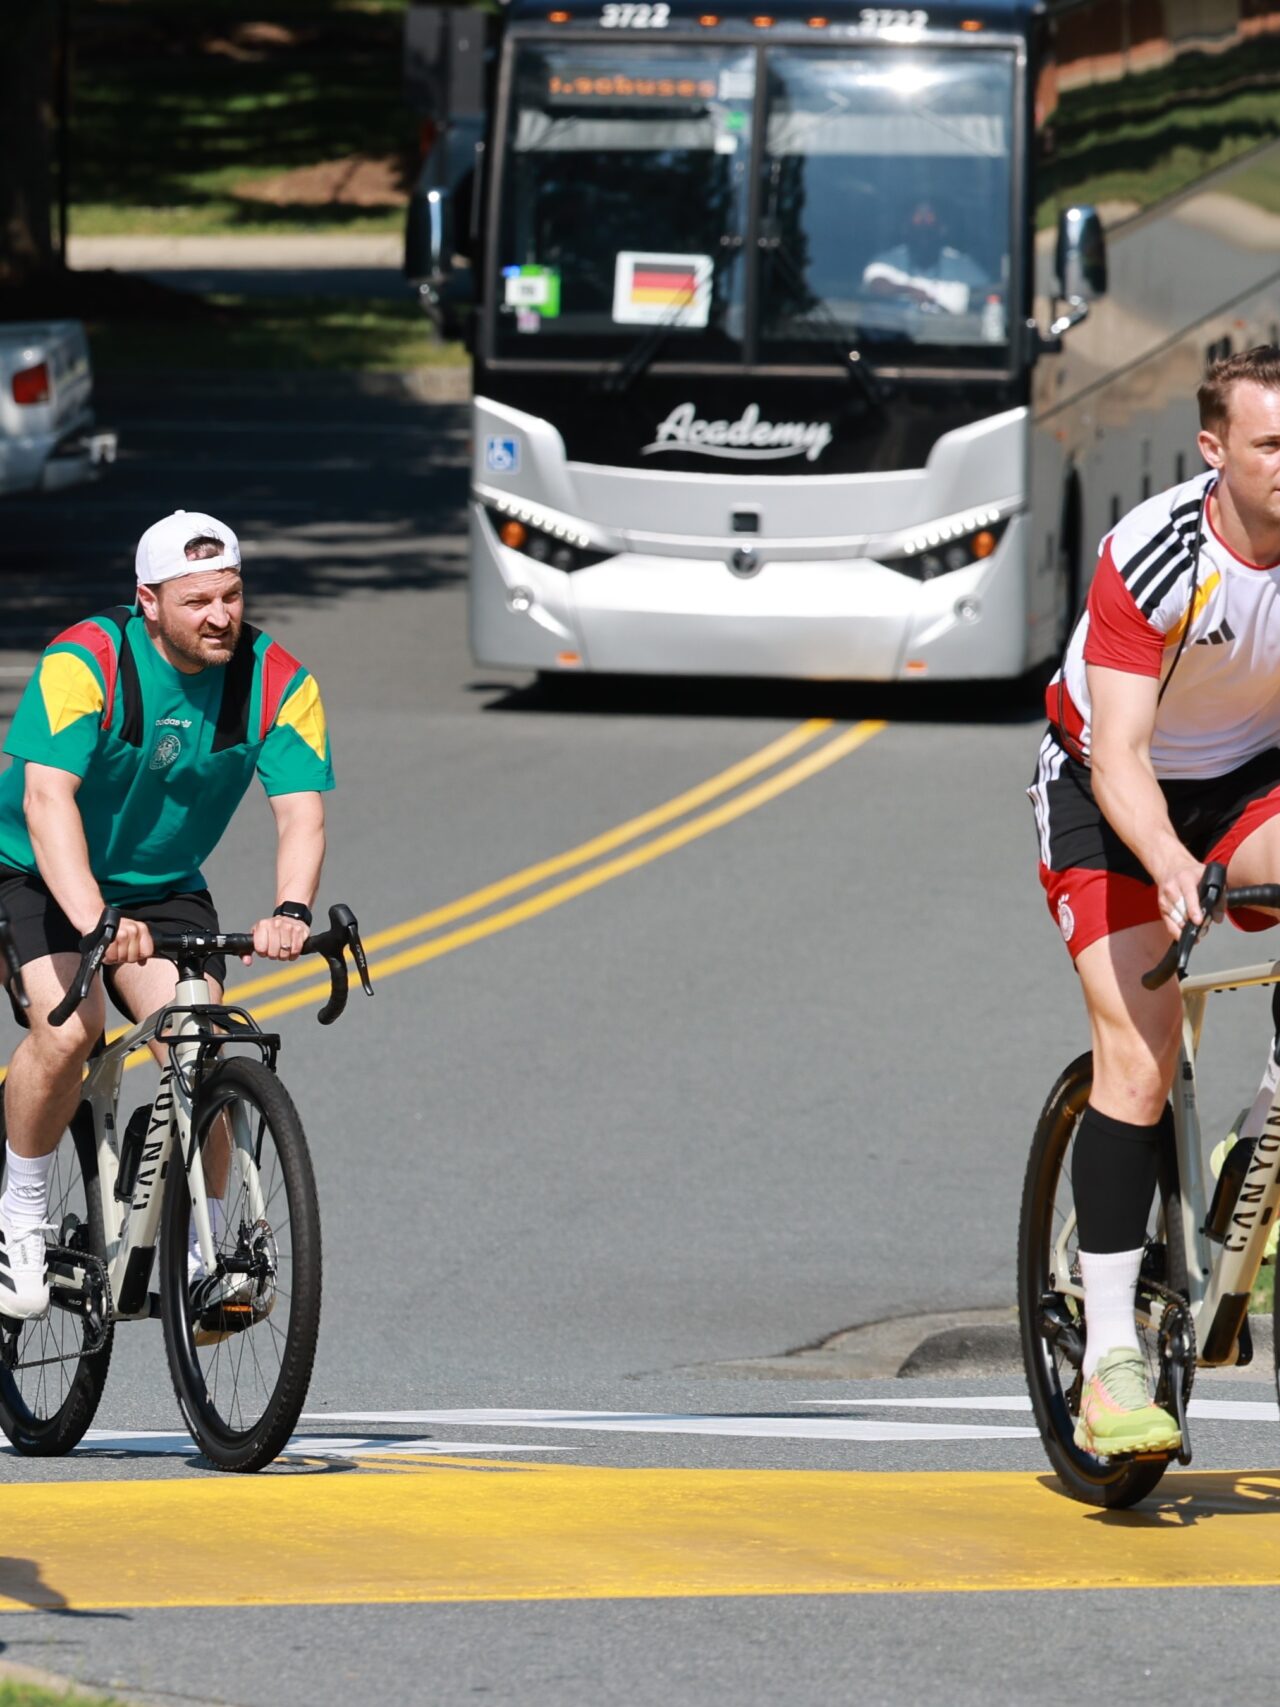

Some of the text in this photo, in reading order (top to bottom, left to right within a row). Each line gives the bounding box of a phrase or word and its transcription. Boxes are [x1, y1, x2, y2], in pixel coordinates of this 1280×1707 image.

[599, 3, 670, 28] 3722
[655, 402, 833, 461] Academy
[155, 718, 180, 726] adidas
[132, 1065, 174, 1210] CANYON
